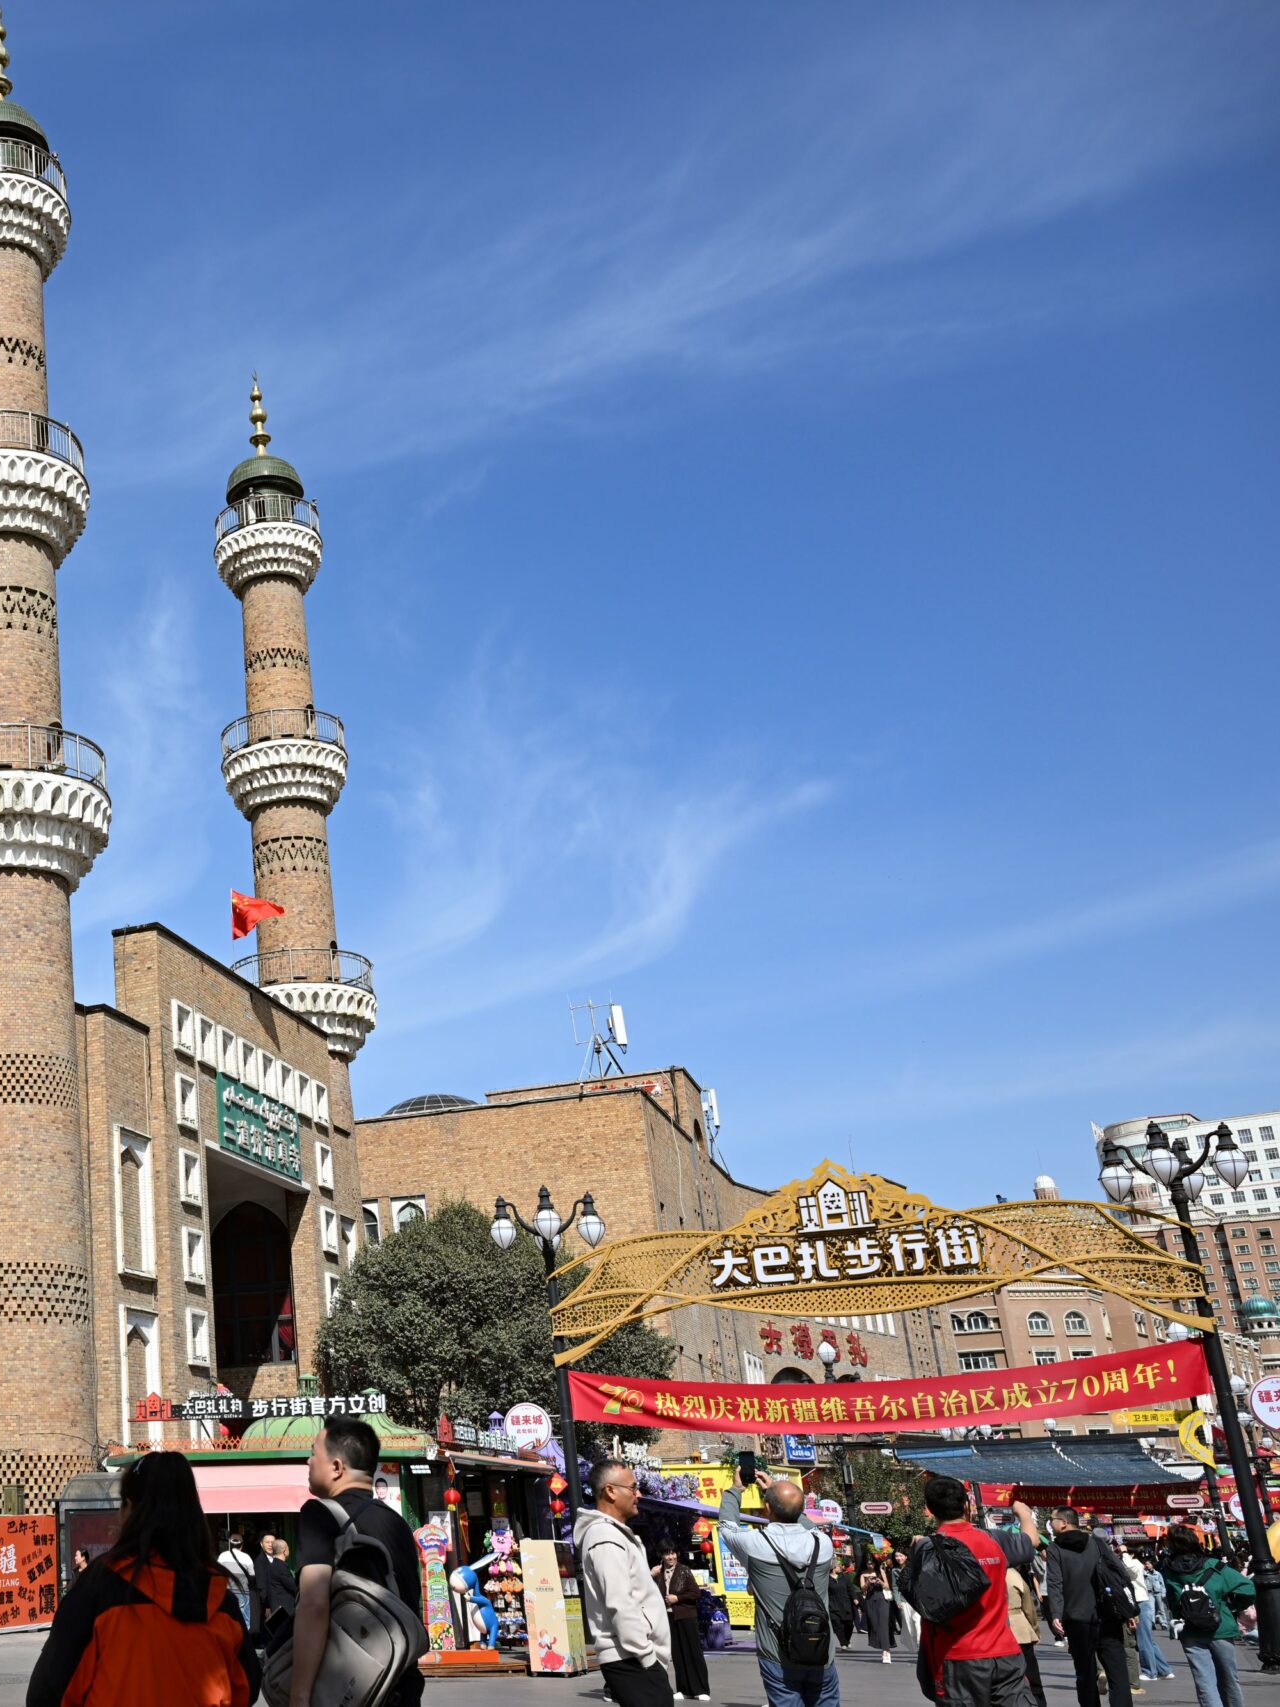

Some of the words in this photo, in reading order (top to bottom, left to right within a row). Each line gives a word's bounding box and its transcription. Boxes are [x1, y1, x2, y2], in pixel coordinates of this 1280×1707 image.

[710, 1225, 983, 1287] 大巴扎步行街
[654, 1359, 1177, 1423] 热烈庆祝新疆维吾尔自治区成立70周年！
[252, 1394, 387, 1417] 步行街官方文创
[1133, 1413, 1159, 1422] 卫生间
[510, 1414, 543, 1426] 疆来城
[0, 1544, 17, 1575] 疆
[27, 1554, 54, 1584] 亚克西
[0, 1578, 20, 1589] JIANG
